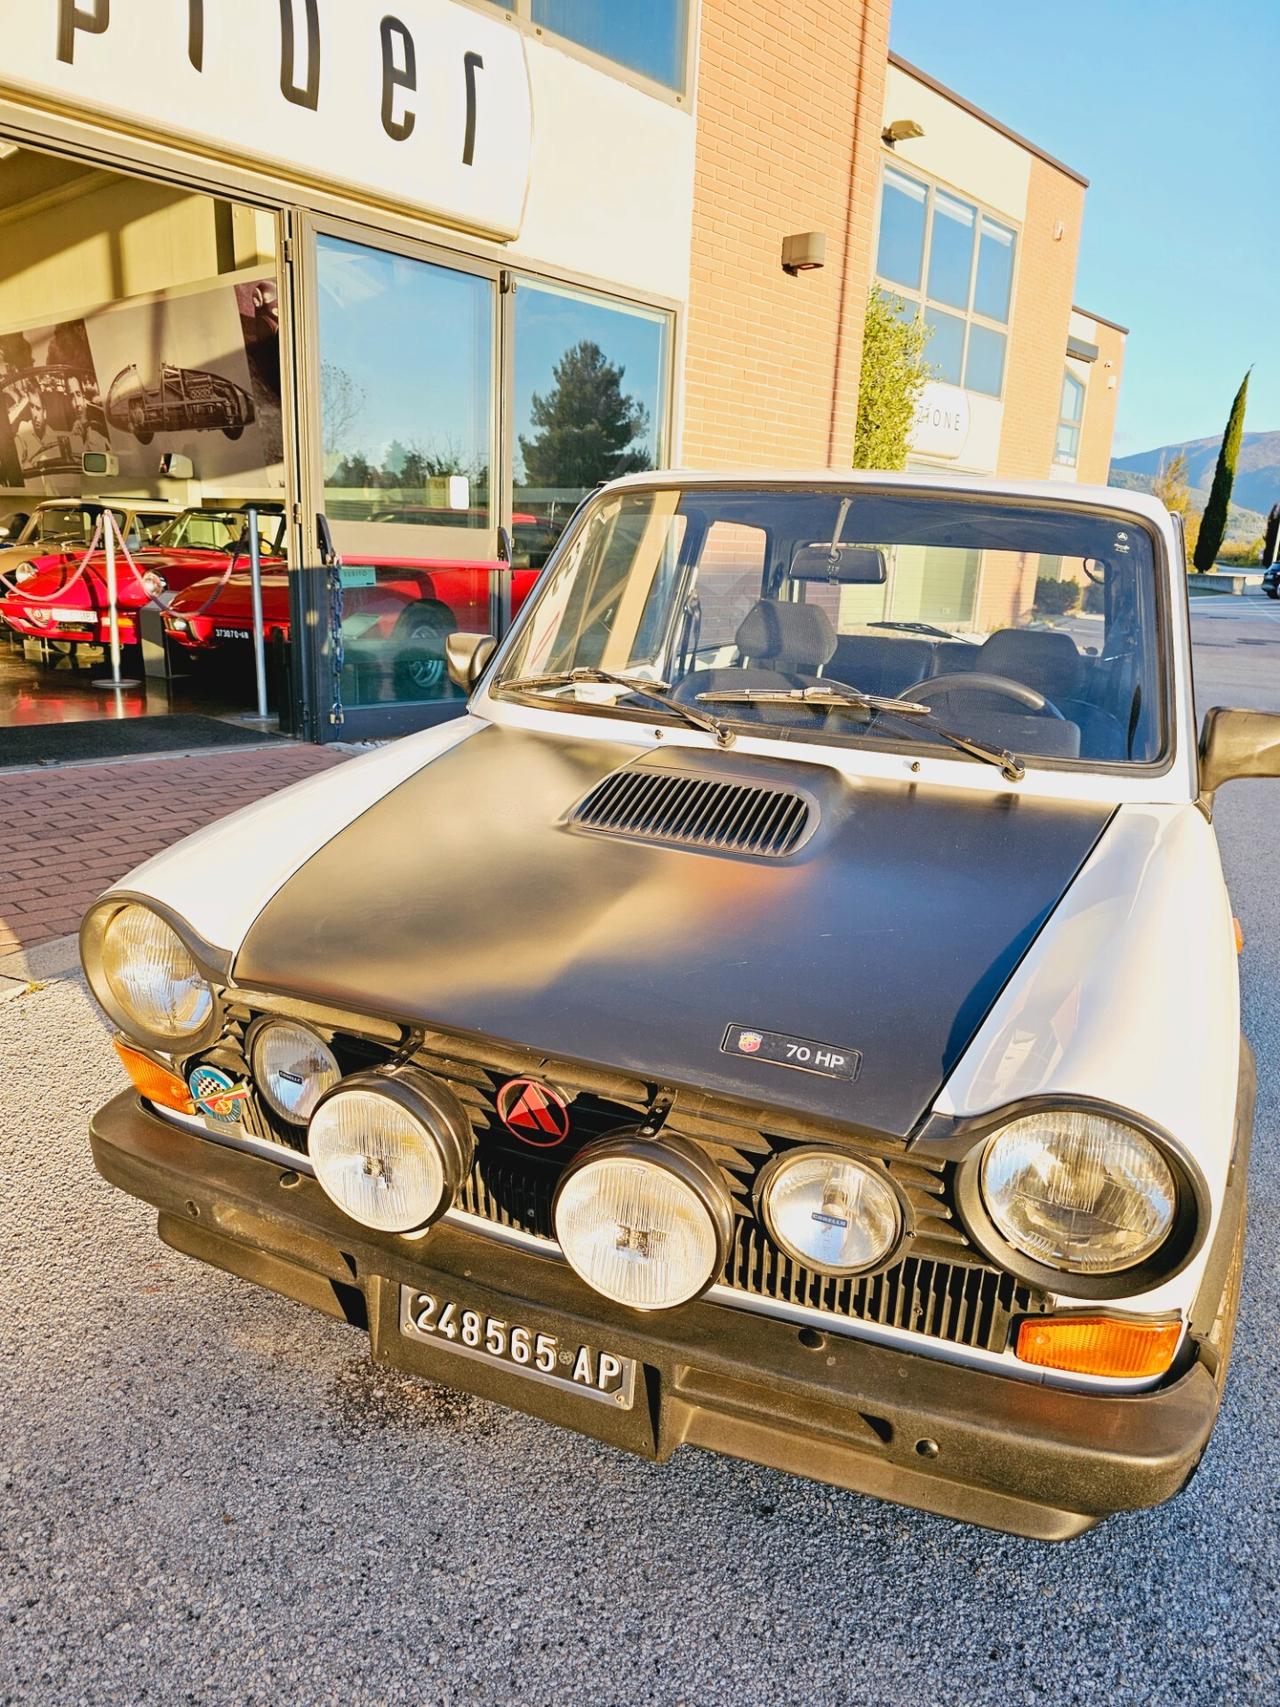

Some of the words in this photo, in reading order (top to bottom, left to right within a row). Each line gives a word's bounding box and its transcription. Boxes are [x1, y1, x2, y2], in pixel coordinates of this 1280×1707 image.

[786, 1043, 811, 1061] 70
[815, 1050, 845, 1068] HP
[416, 1293, 558, 1373] 248565
[572, 1345, 622, 1389] AP
